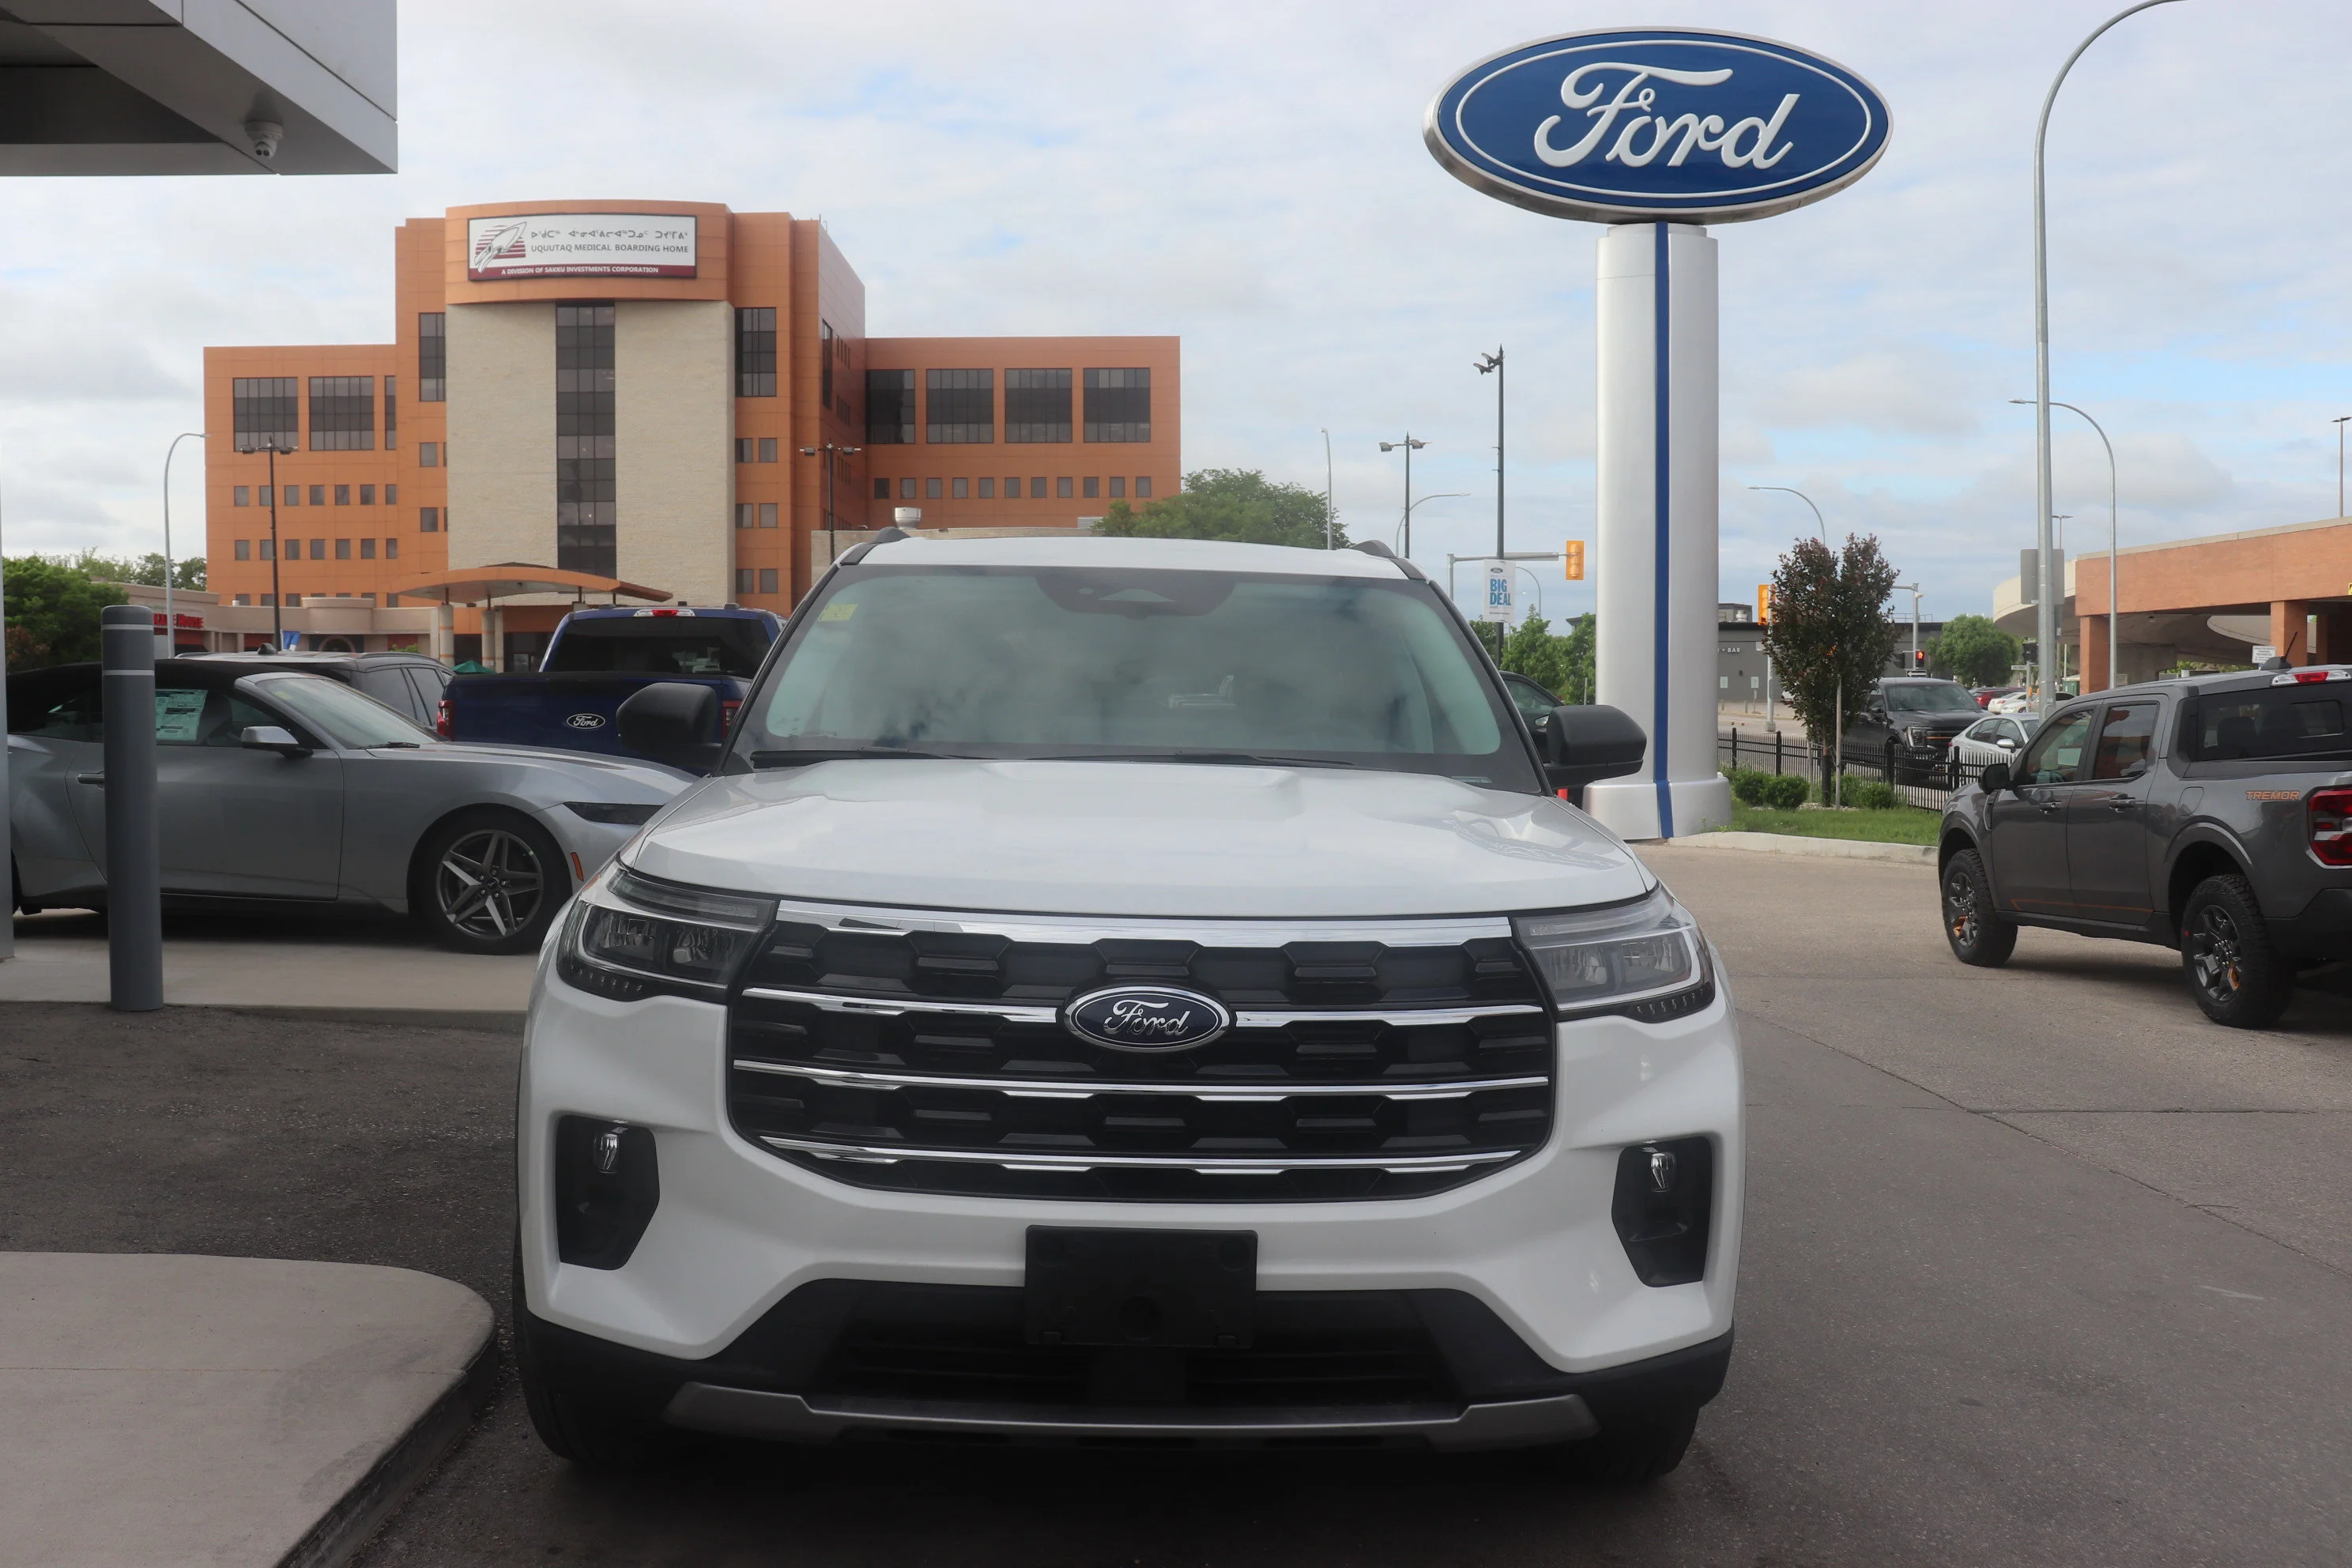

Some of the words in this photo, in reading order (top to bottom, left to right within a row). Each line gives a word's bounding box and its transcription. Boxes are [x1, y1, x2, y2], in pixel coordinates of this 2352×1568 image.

[1533, 62, 1800, 169] Ford
[1490, 579, 1507, 592] BIG
[1490, 592, 1511, 605] DEAL
[573, 715, 598, 726] Ford
[2245, 790, 2301, 801] TREMOR
[1103, 999, 1191, 1035] Ford
